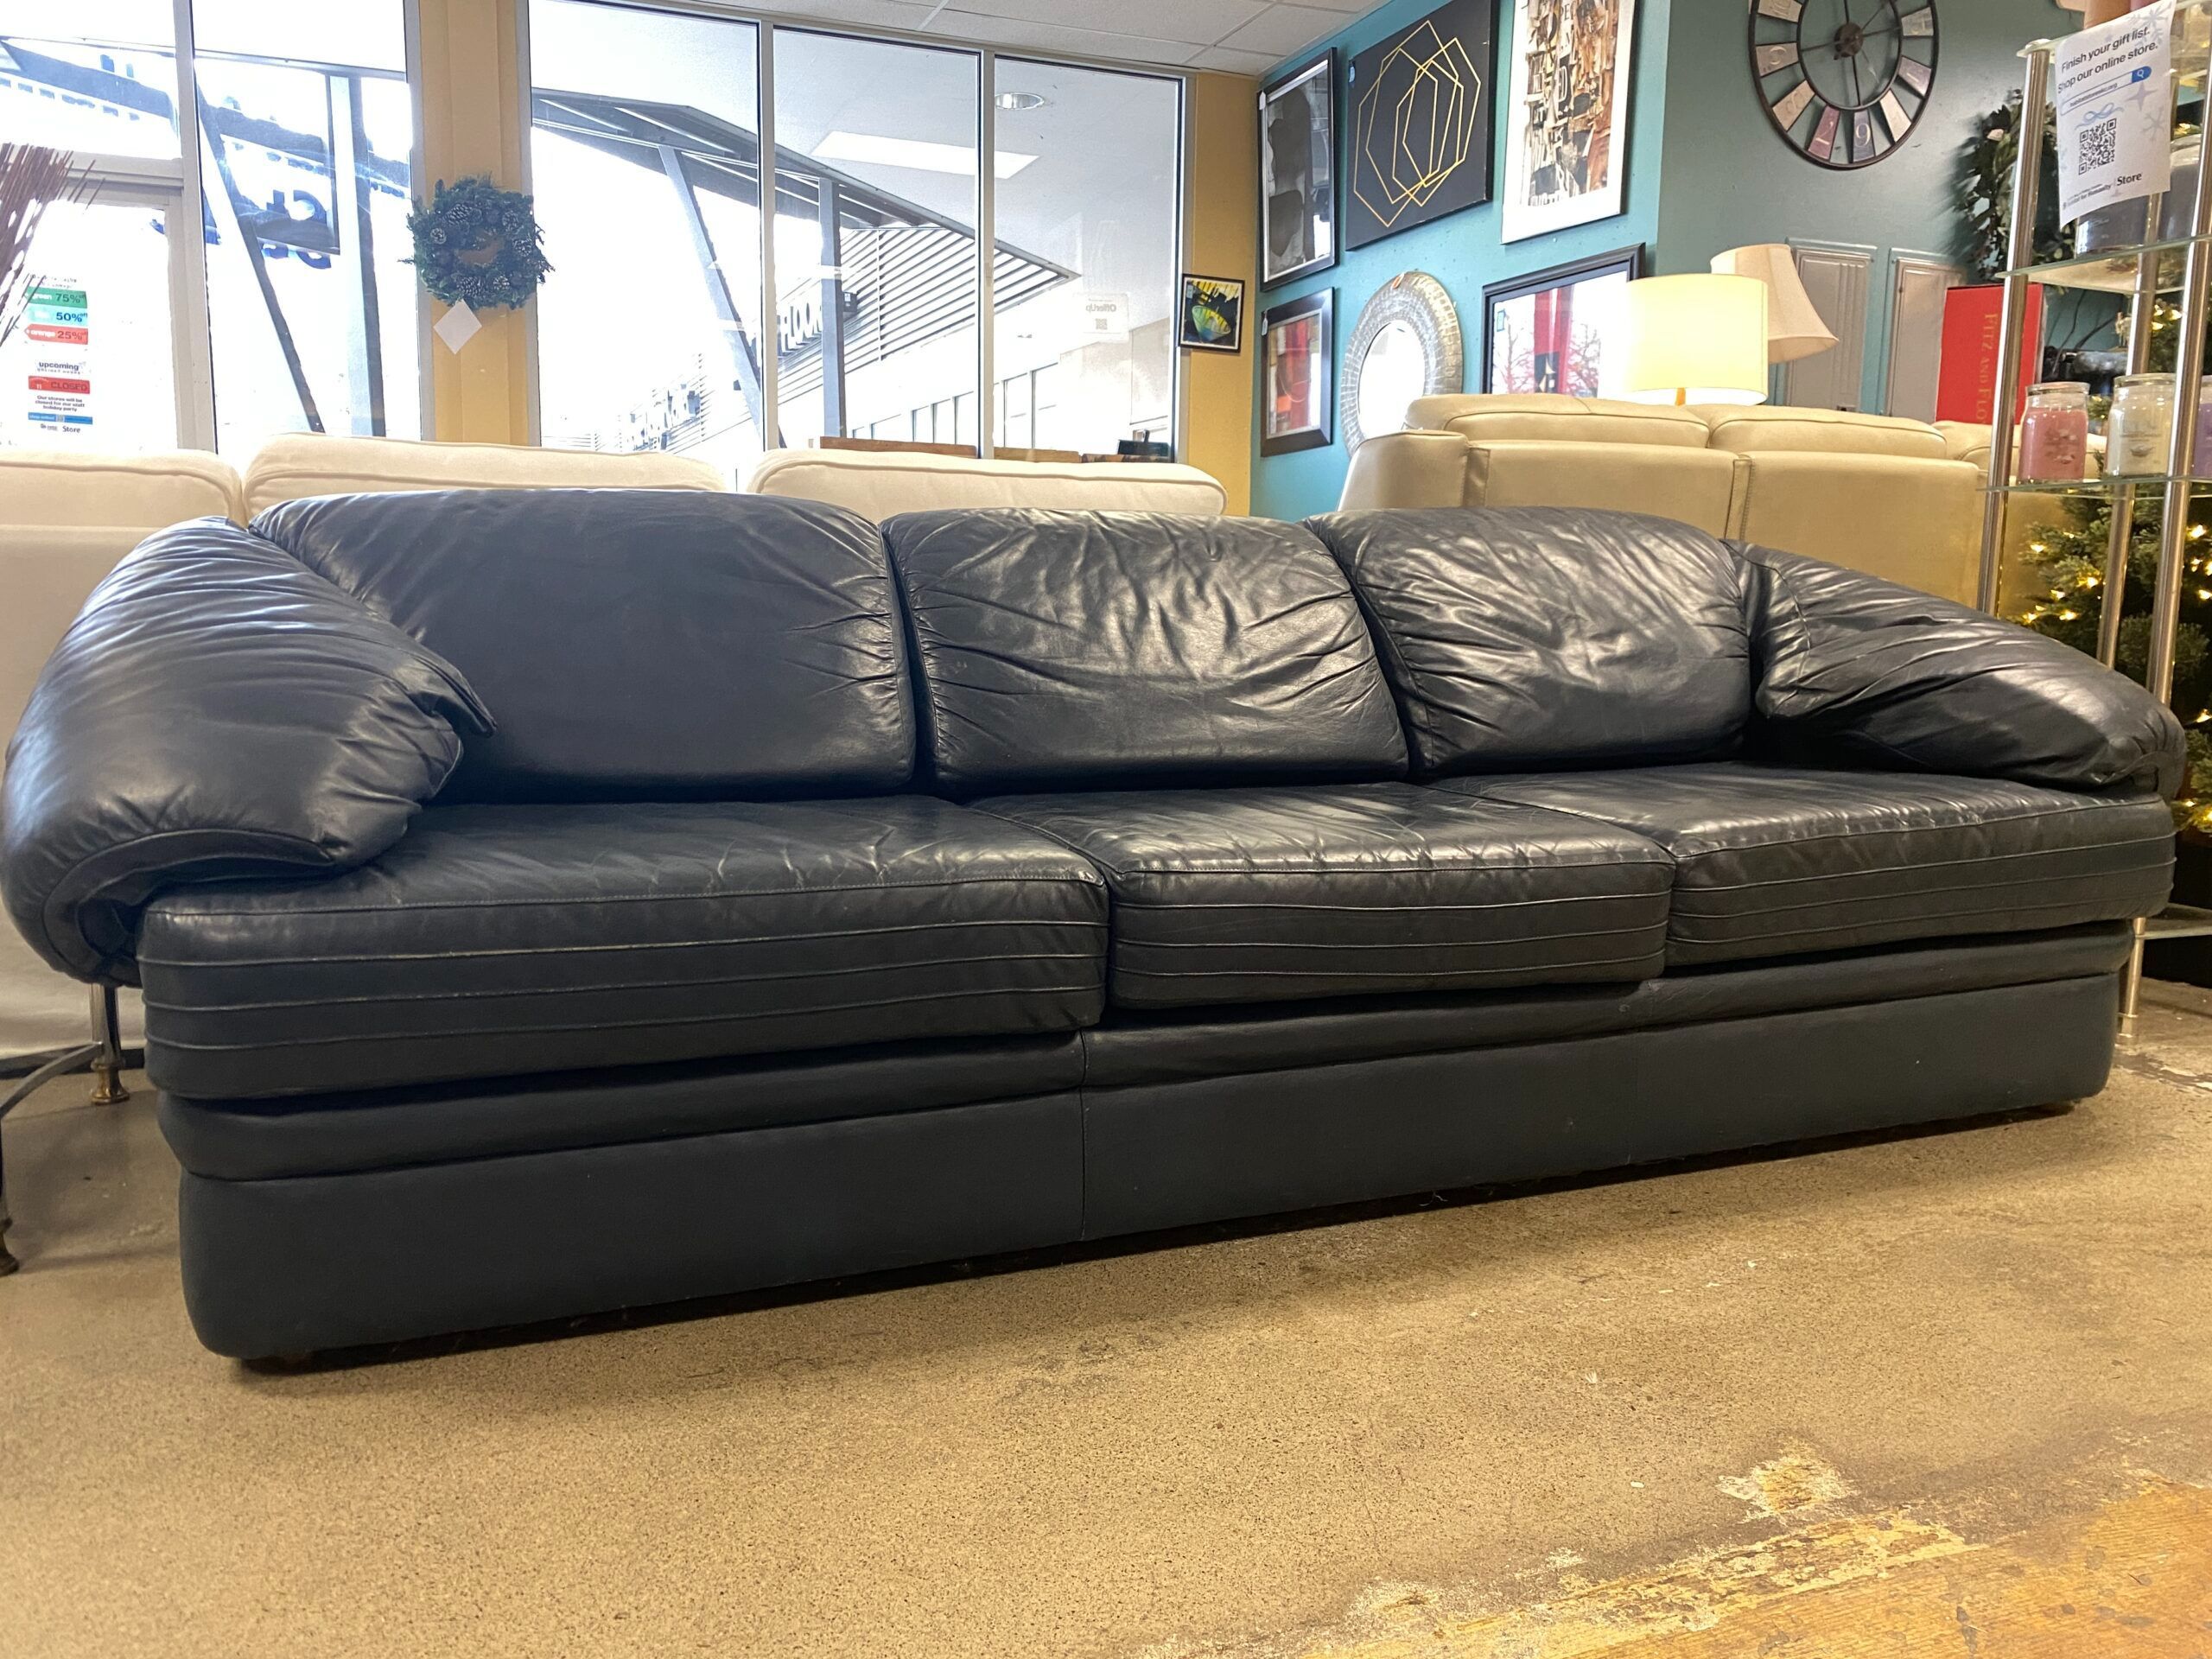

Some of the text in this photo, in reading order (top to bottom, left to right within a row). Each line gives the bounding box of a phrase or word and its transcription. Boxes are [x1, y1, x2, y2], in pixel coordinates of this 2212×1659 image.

[2062, 26, 2150, 73] Finish your gift list.
[2076, 68, 2094, 82] our
[2094, 54, 2126, 73] online
[2127, 41, 2158, 60] store.
[2117, 173, 2142, 187] Store
[55, 293, 80, 304] 75%
[56, 312, 83, 323] 50%
[57, 331, 82, 341] 25%
[39, 362, 79, 372] upcoming
[1976, 313, 1999, 423] FITZ AND FLO
[51, 381, 87, 391] CLOSED
